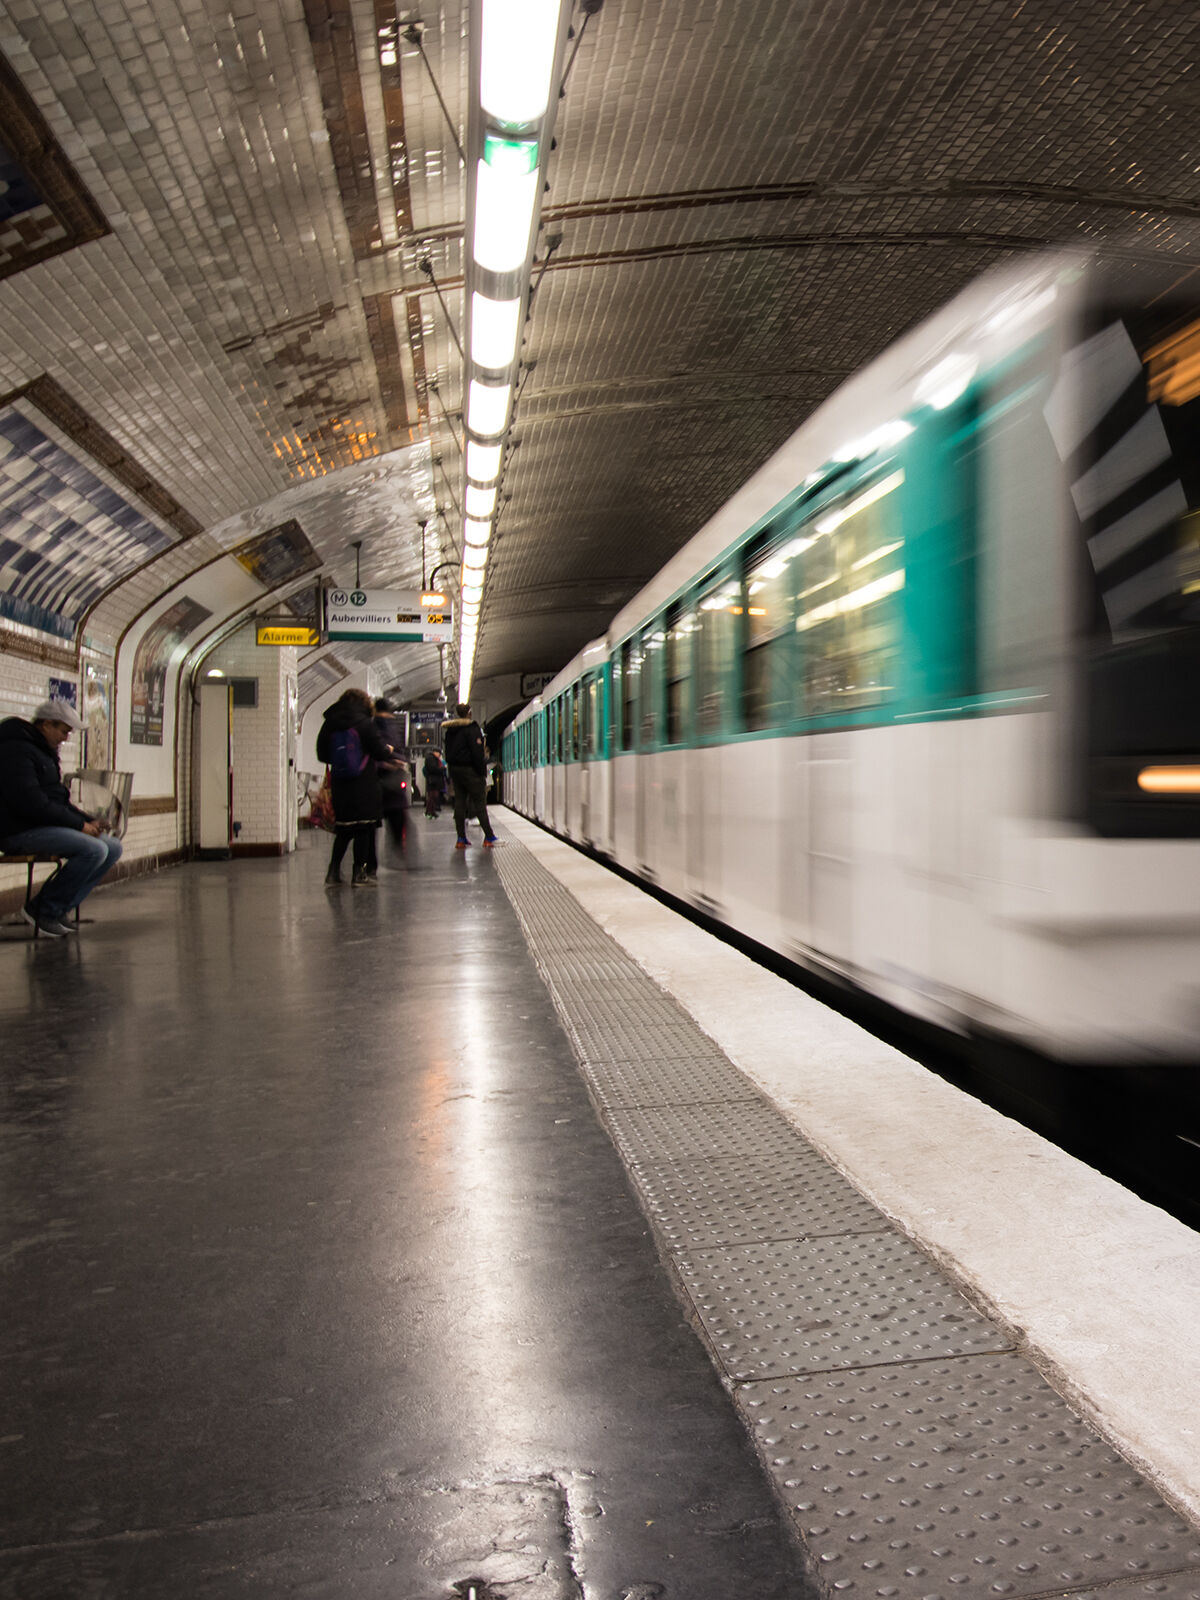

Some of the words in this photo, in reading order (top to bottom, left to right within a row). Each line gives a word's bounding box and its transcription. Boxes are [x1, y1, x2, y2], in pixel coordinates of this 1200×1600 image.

[352, 592, 365, 605] 12
[331, 613, 391, 624] Aubervilliers
[263, 632, 303, 641] Alarme
